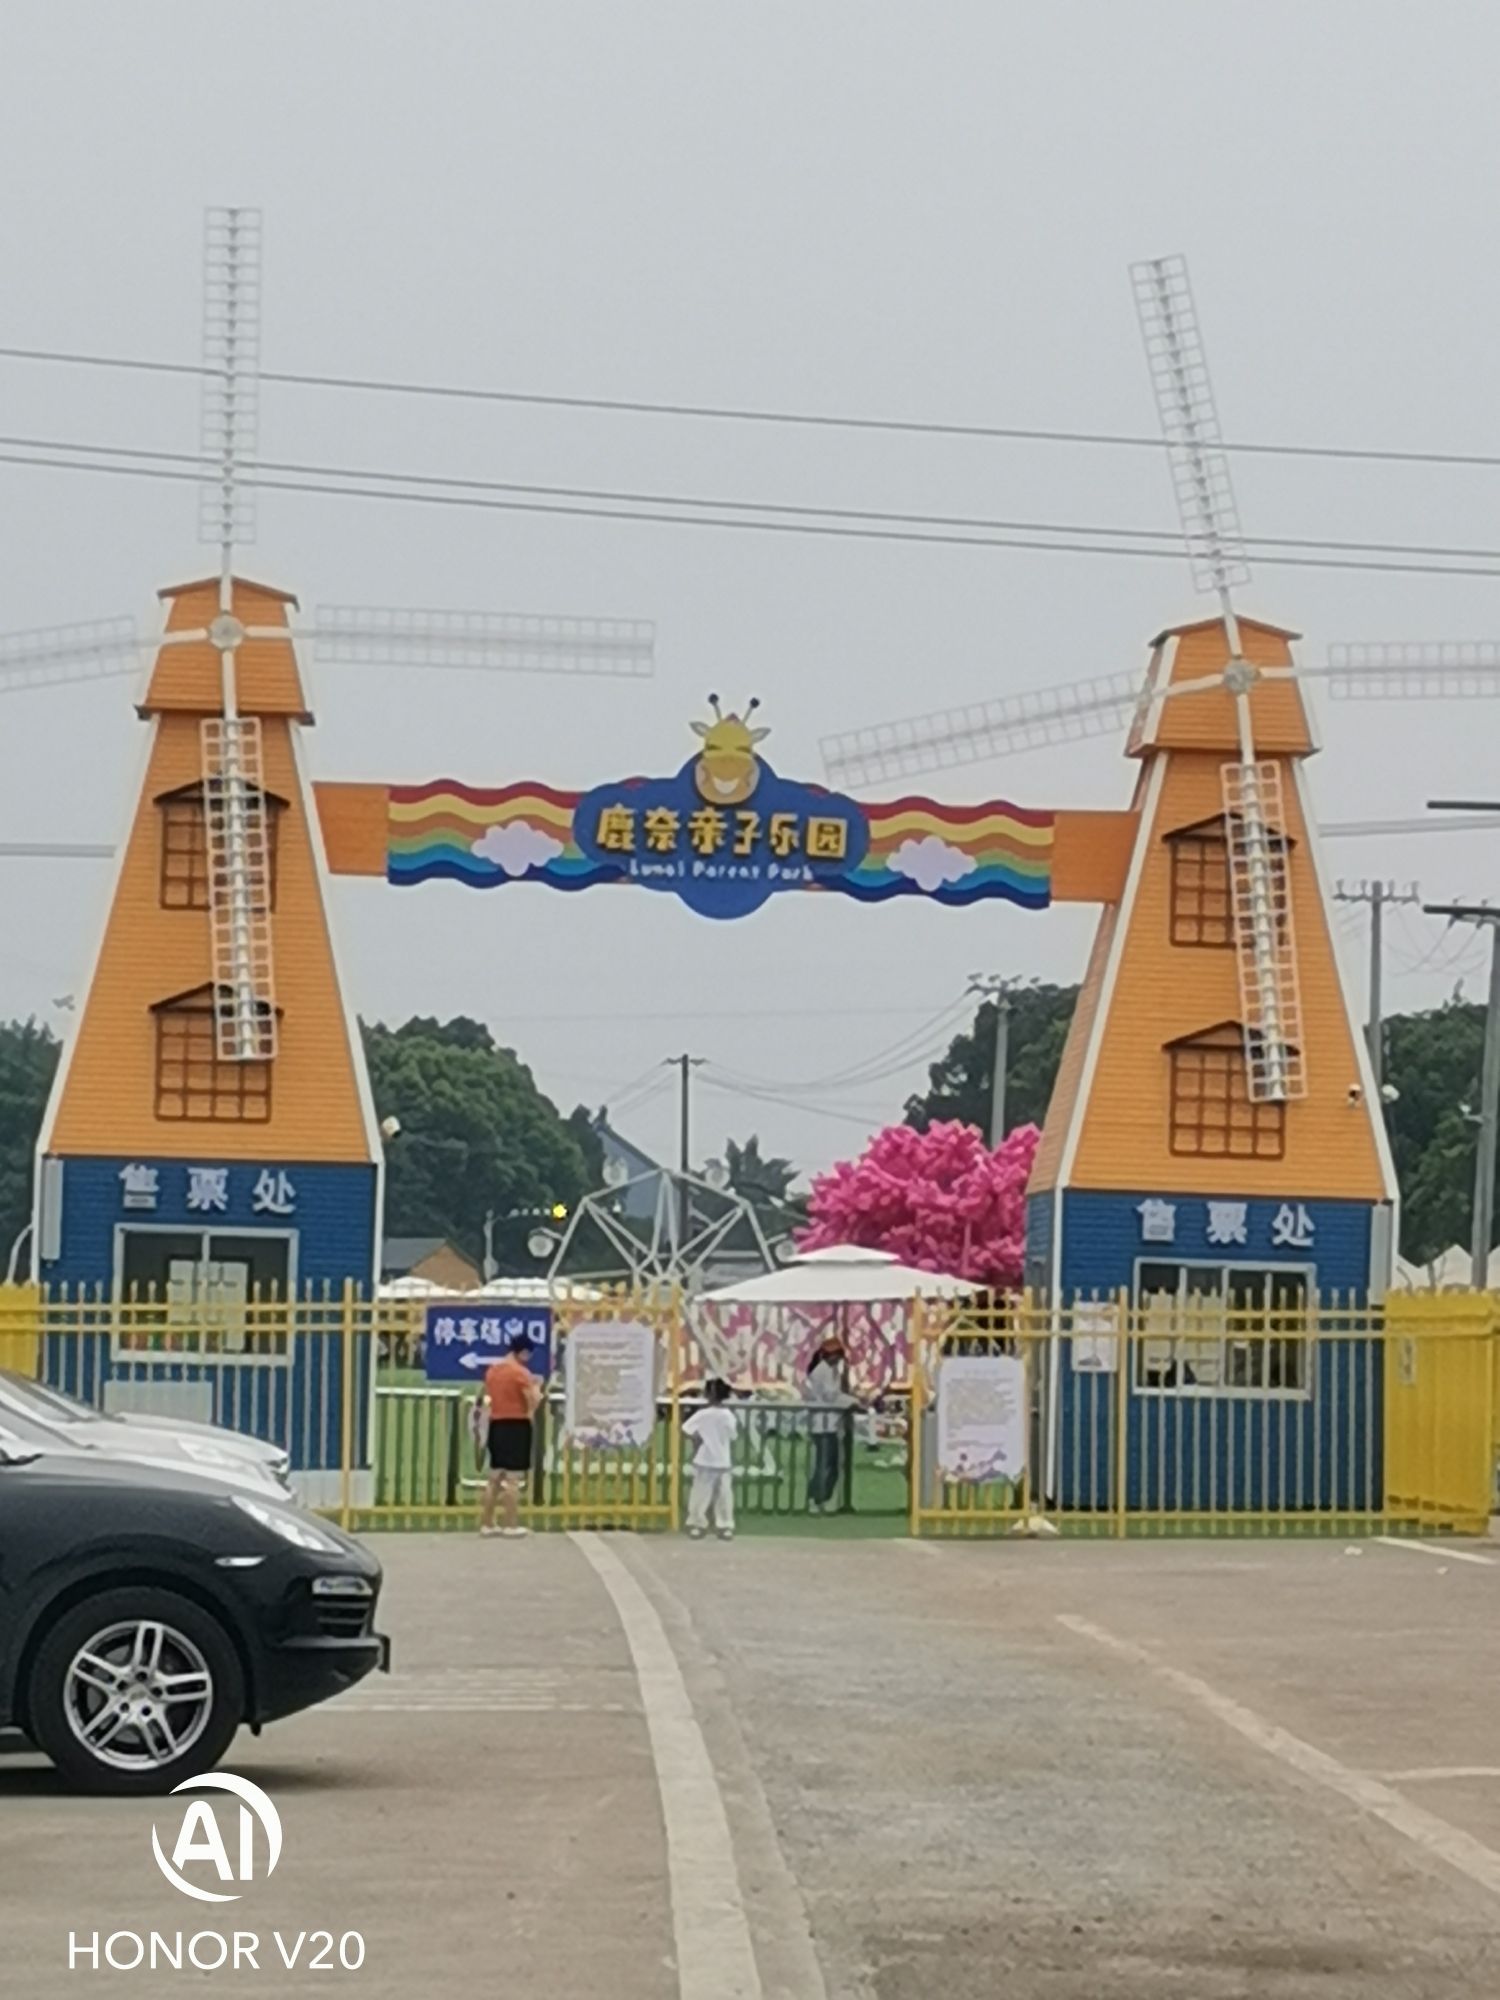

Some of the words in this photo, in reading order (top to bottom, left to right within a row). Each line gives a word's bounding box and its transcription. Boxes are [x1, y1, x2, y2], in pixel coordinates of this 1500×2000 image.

[596, 803, 847, 859] 鹿奈亲子乐园
[119, 1163, 296, 1214] 售票处
[1136, 1198, 1315, 1247] 售票处
